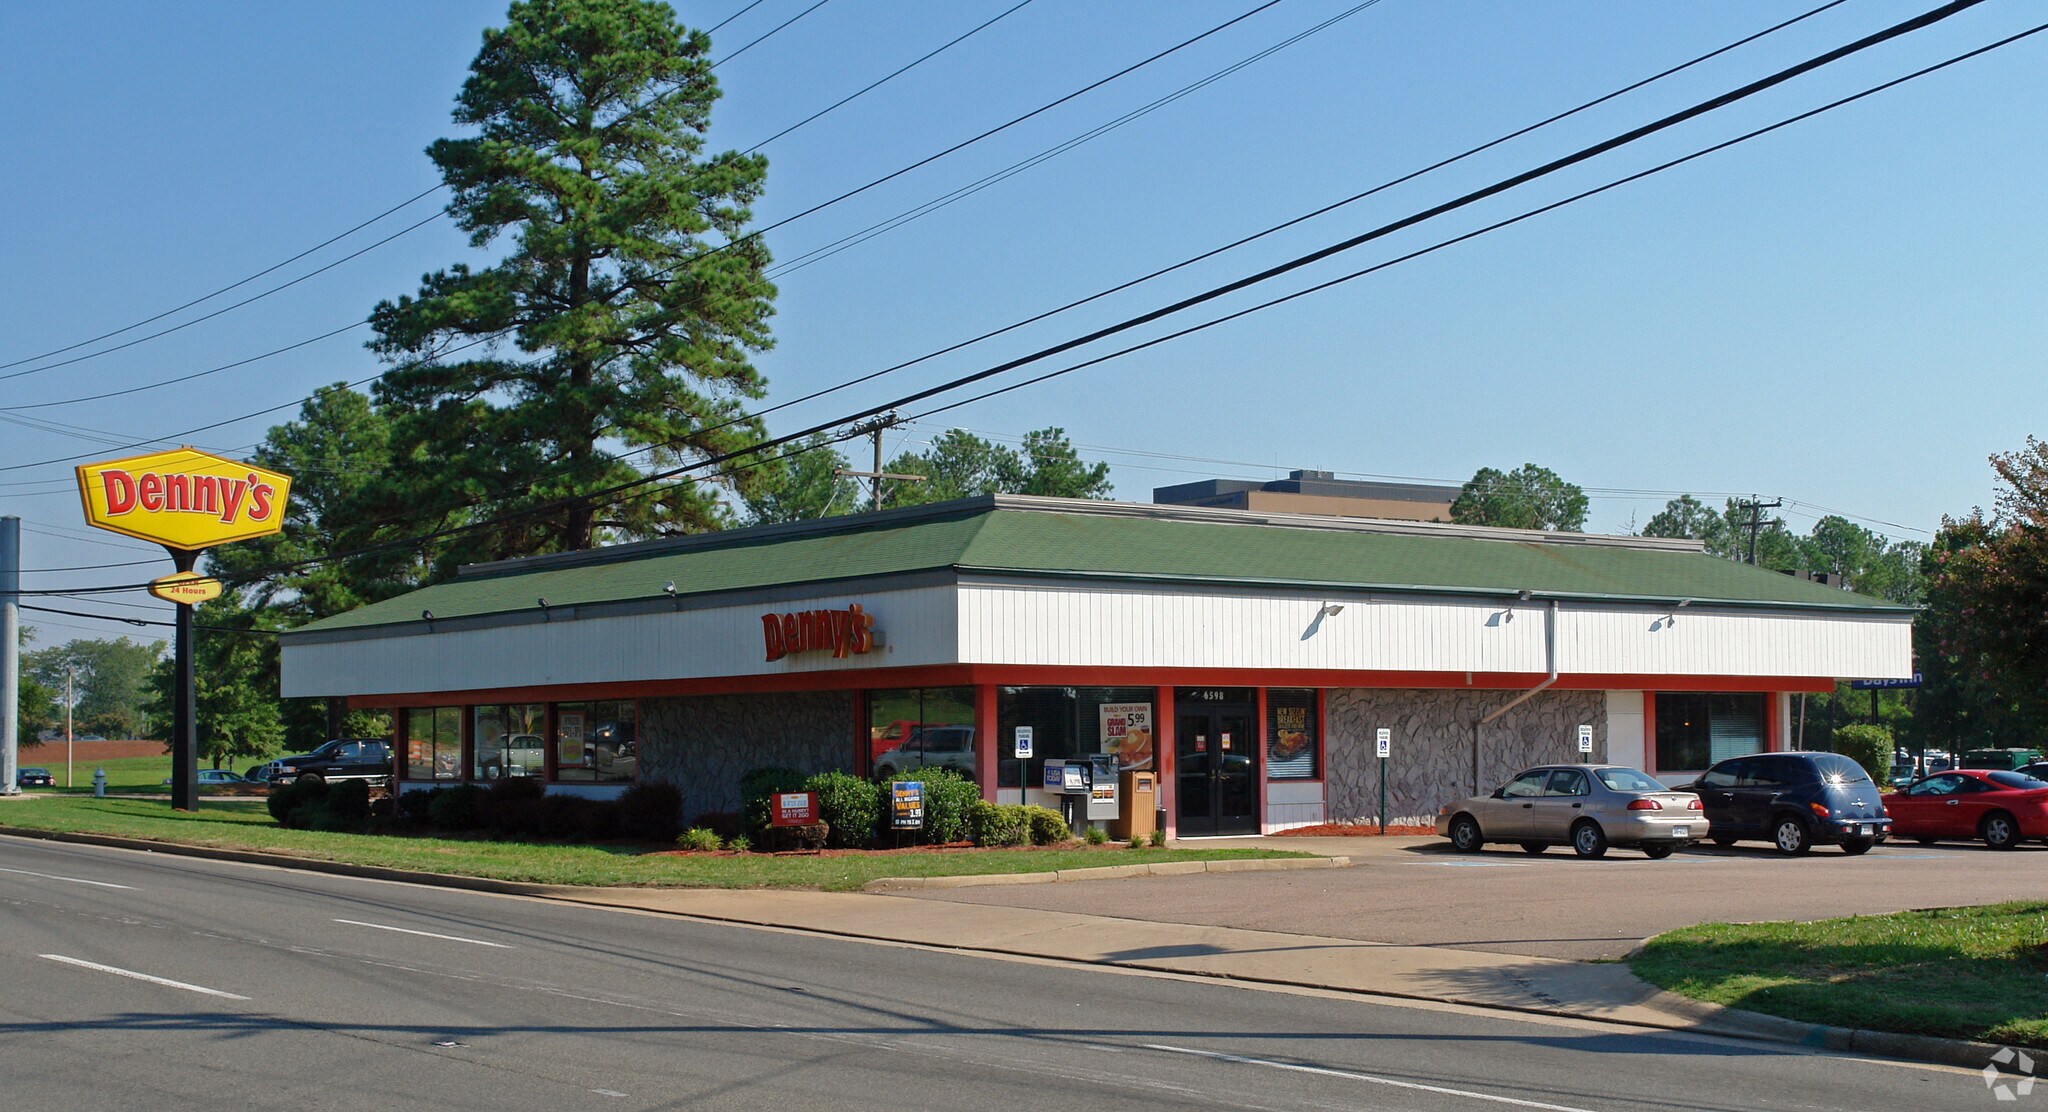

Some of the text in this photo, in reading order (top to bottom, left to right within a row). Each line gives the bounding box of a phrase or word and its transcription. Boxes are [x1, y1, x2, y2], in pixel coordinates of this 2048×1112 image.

[99, 469, 275, 524] Denny's
[761, 603, 874, 662] Denny's
[1203, 691, 1224, 700] 6598
[1107, 718, 1126, 726] GRAND
[1107, 726, 1127, 736] SLAM
[896, 802, 920, 810] VALUES
